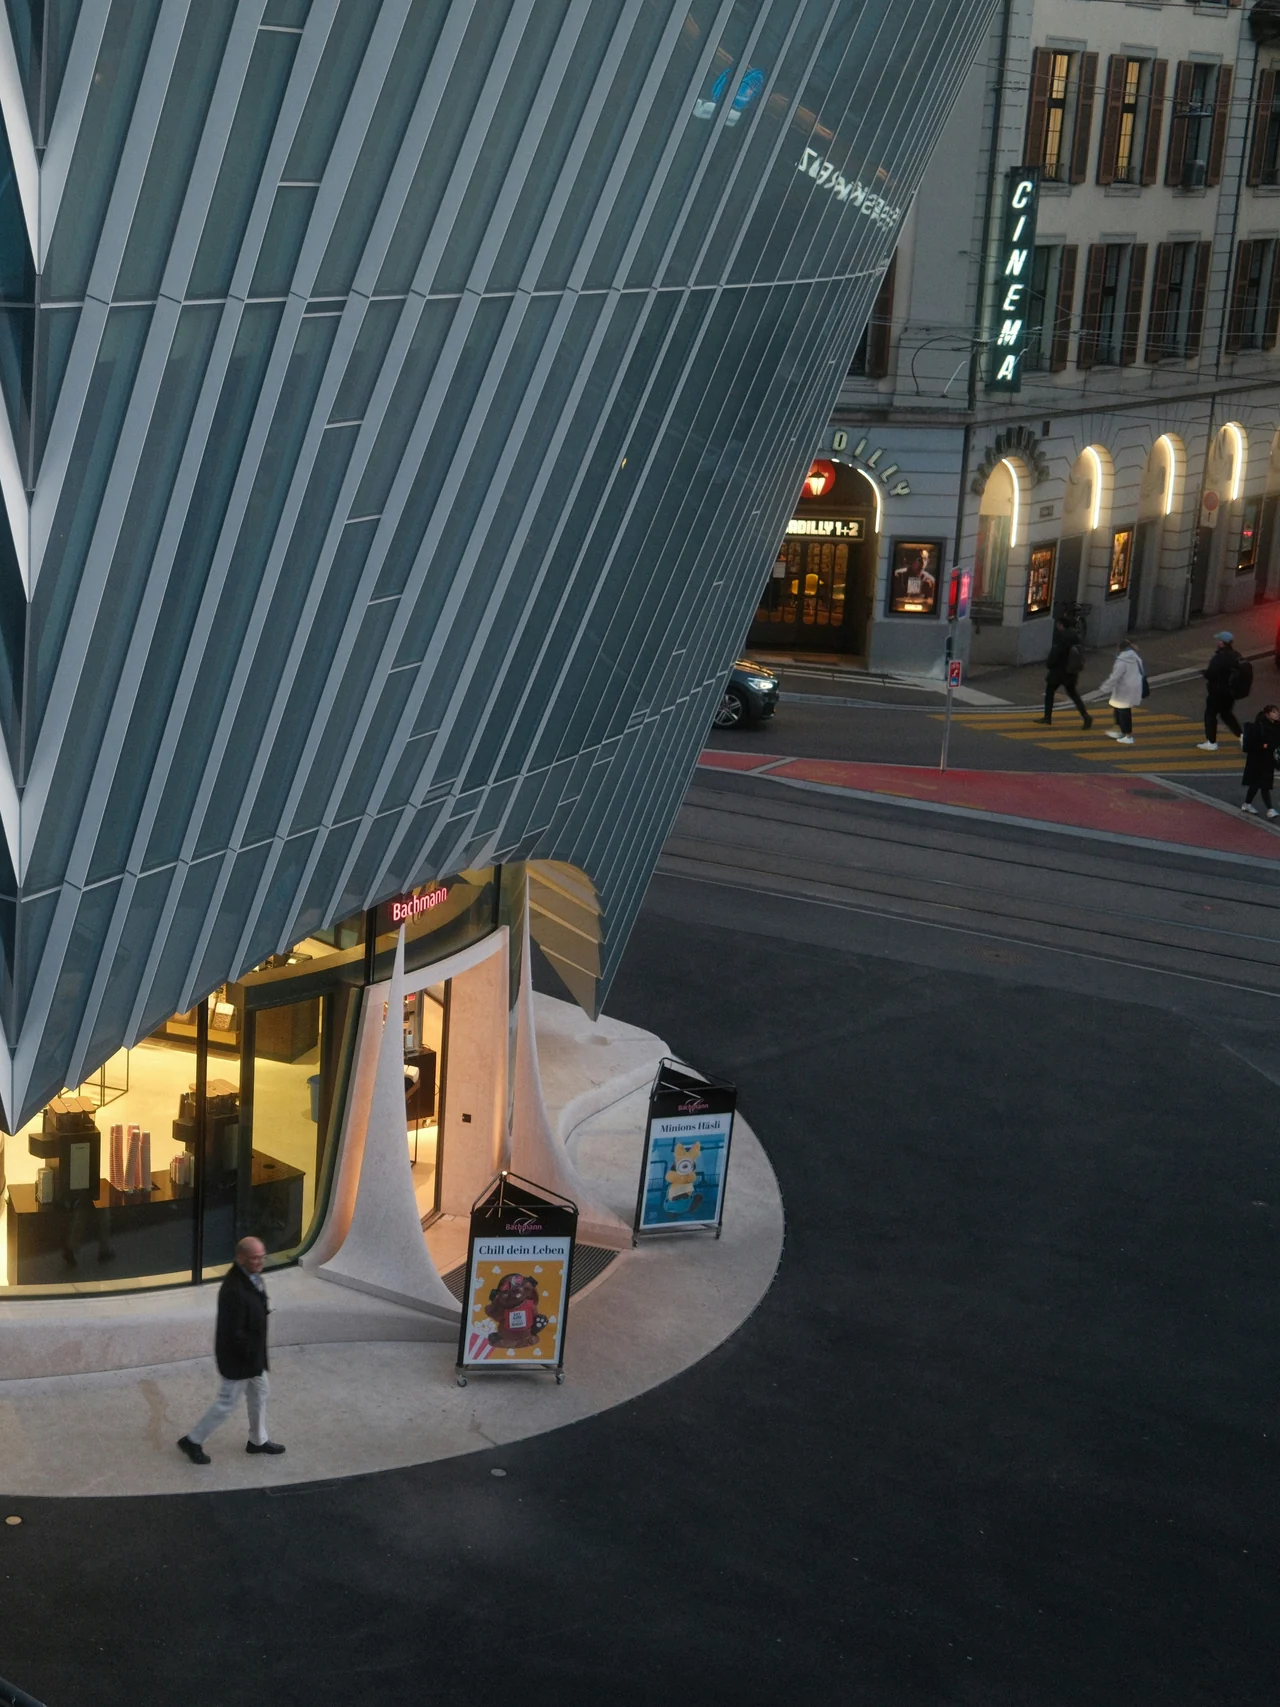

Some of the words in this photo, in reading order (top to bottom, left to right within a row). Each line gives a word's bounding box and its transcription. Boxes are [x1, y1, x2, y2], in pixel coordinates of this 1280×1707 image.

[996, 180, 1033, 381] CINEMA
[832, 430, 911, 497] DILLY
[786, 519, 834, 535] ADILLY
[835, 521, 859, 537] 1+2
[393, 887, 447, 921] Bachmann
[661, 1122, 696, 1133] Minions
[505, 1222, 543, 1232] Bachmann
[478, 1244, 505, 1255] Chill
[506, 1244, 530, 1255] dein
[532, 1245, 565, 1255] Leben
